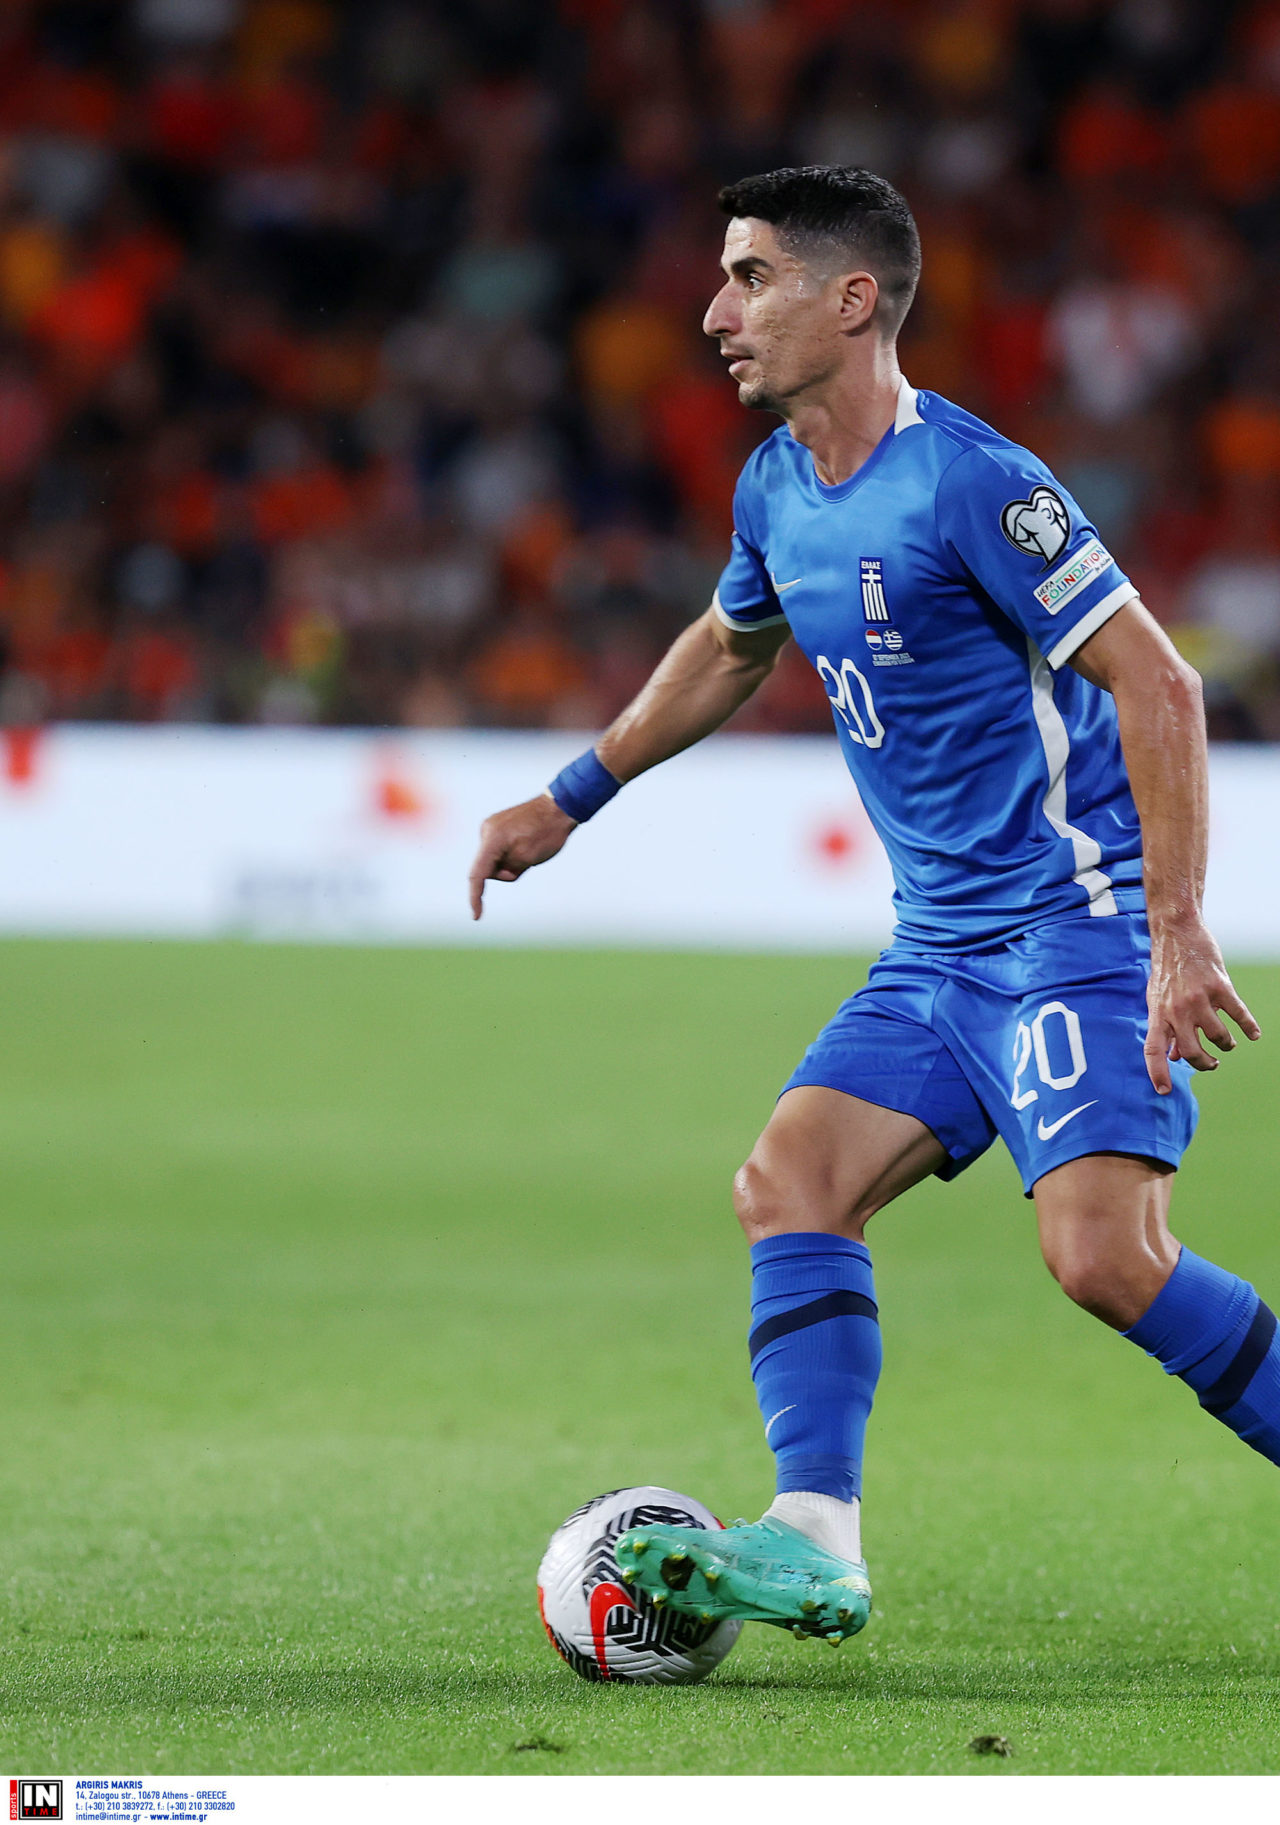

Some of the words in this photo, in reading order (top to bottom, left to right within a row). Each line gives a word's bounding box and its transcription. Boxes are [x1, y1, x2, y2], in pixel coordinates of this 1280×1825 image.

[1036, 580, 1055, 597] UEFA
[1041, 546, 1106, 607] FOUNDATION
[816, 655, 886, 749] 20
[1010, 1001, 1088, 1111] 20
